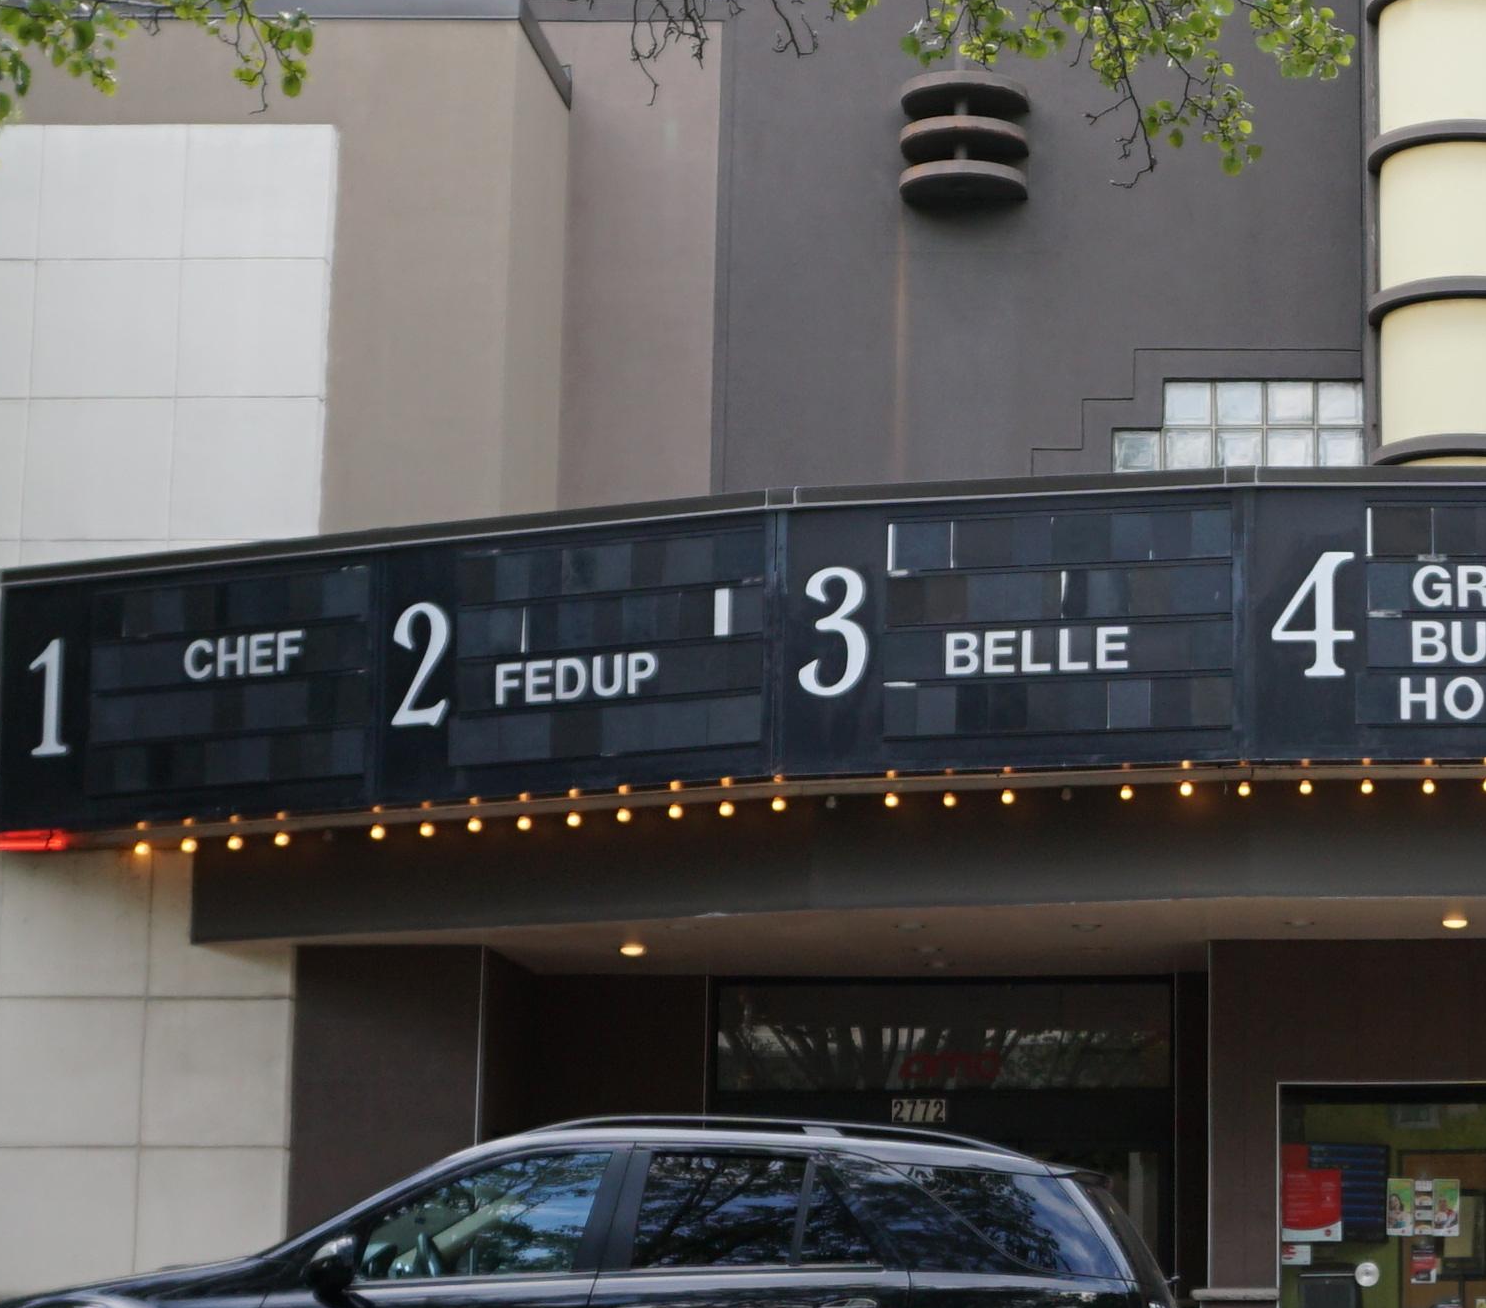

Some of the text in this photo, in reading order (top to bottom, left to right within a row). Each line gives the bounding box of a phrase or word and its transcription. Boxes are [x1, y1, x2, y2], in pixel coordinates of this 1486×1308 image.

[183, 628, 306, 681] CHEF
[797, 566, 869, 698] 3
[943, 625, 1131, 676] BELLE
[1271, 550, 1356, 678] 4
[28, 638, 70, 757] 1
[391, 602, 451, 728] 2
[494, 651, 660, 706] FEDUP
[893, 1100, 944, 1122] 2772
